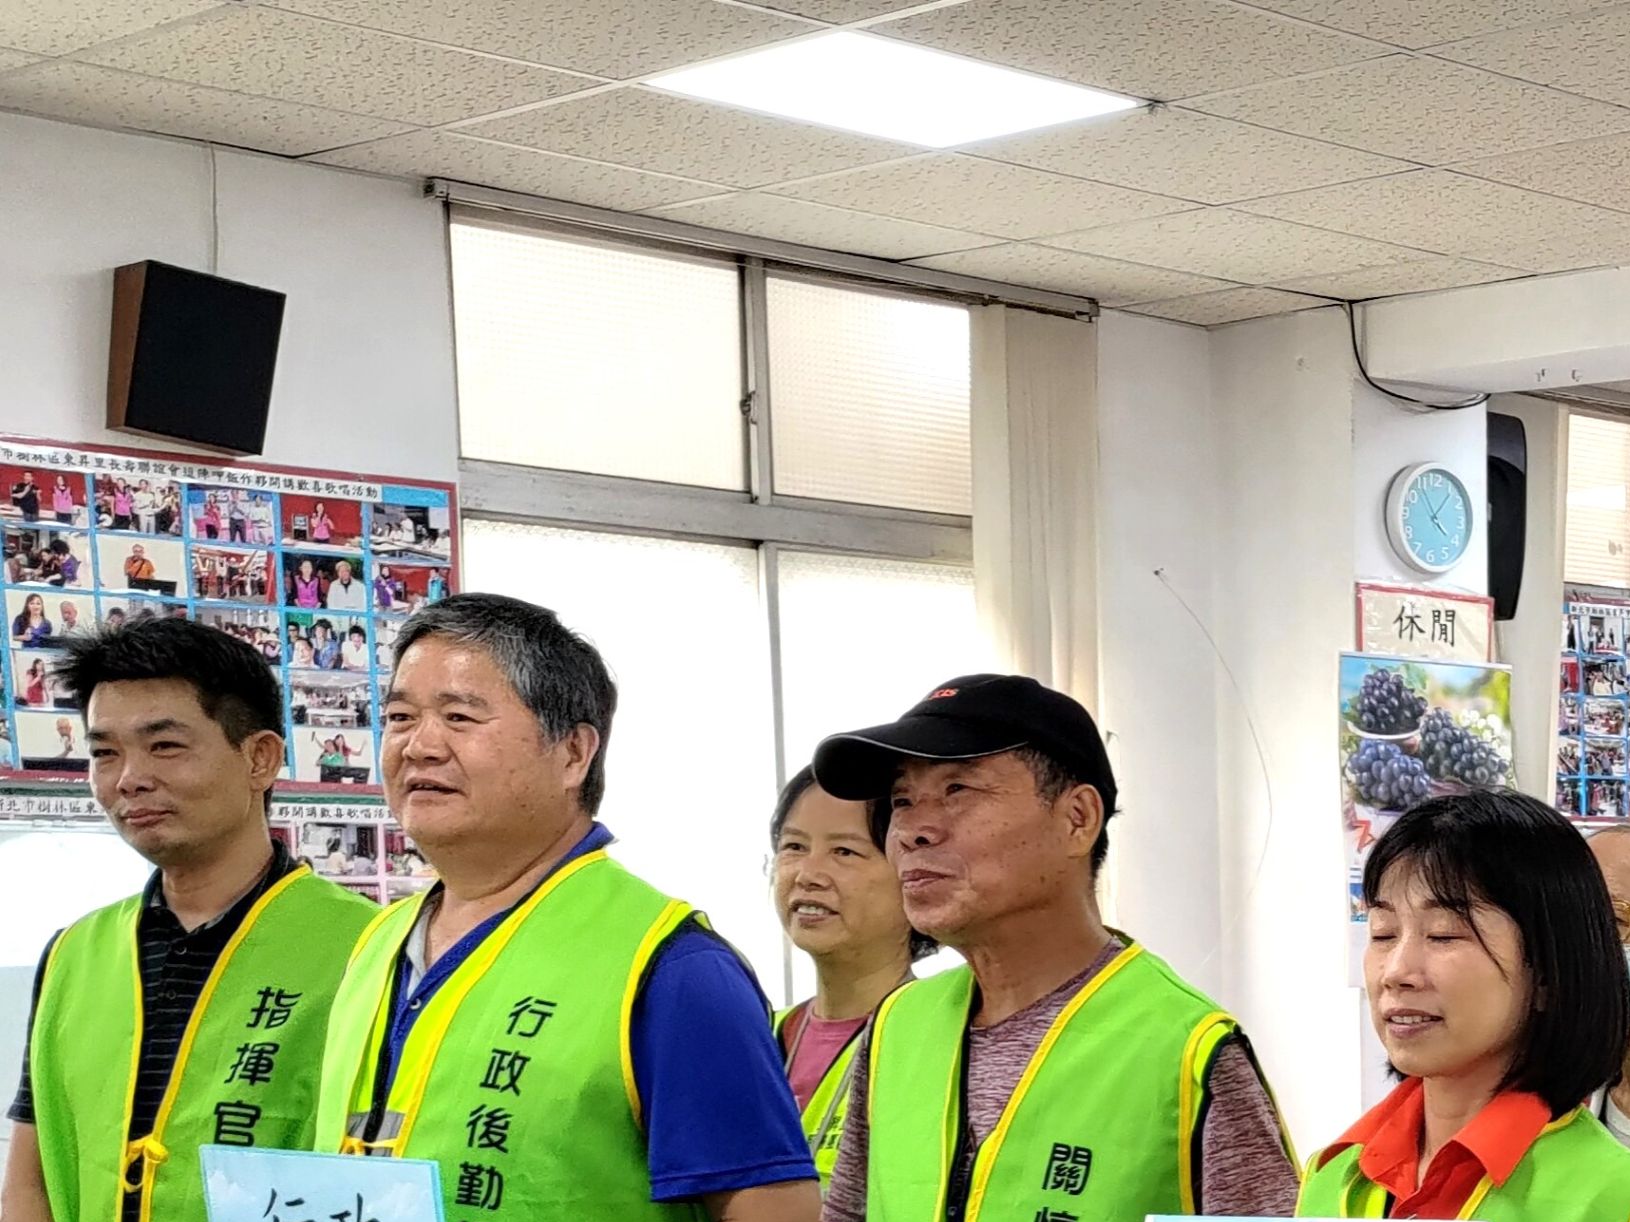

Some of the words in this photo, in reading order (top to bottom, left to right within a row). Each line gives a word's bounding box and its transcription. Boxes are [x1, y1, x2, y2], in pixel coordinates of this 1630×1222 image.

[1429, 473, 1443, 488] 12
[1455, 495, 1463, 510] 2
[1456, 516, 1464, 529] 3
[1405, 525, 1413, 539] 8
[1451, 534, 1460, 547] 4
[1413, 541, 1422, 555] 7
[1441, 546, 1449, 560] 5
[1426, 549, 1435, 563] 6
[213, 986, 303, 1146] 指揮官
